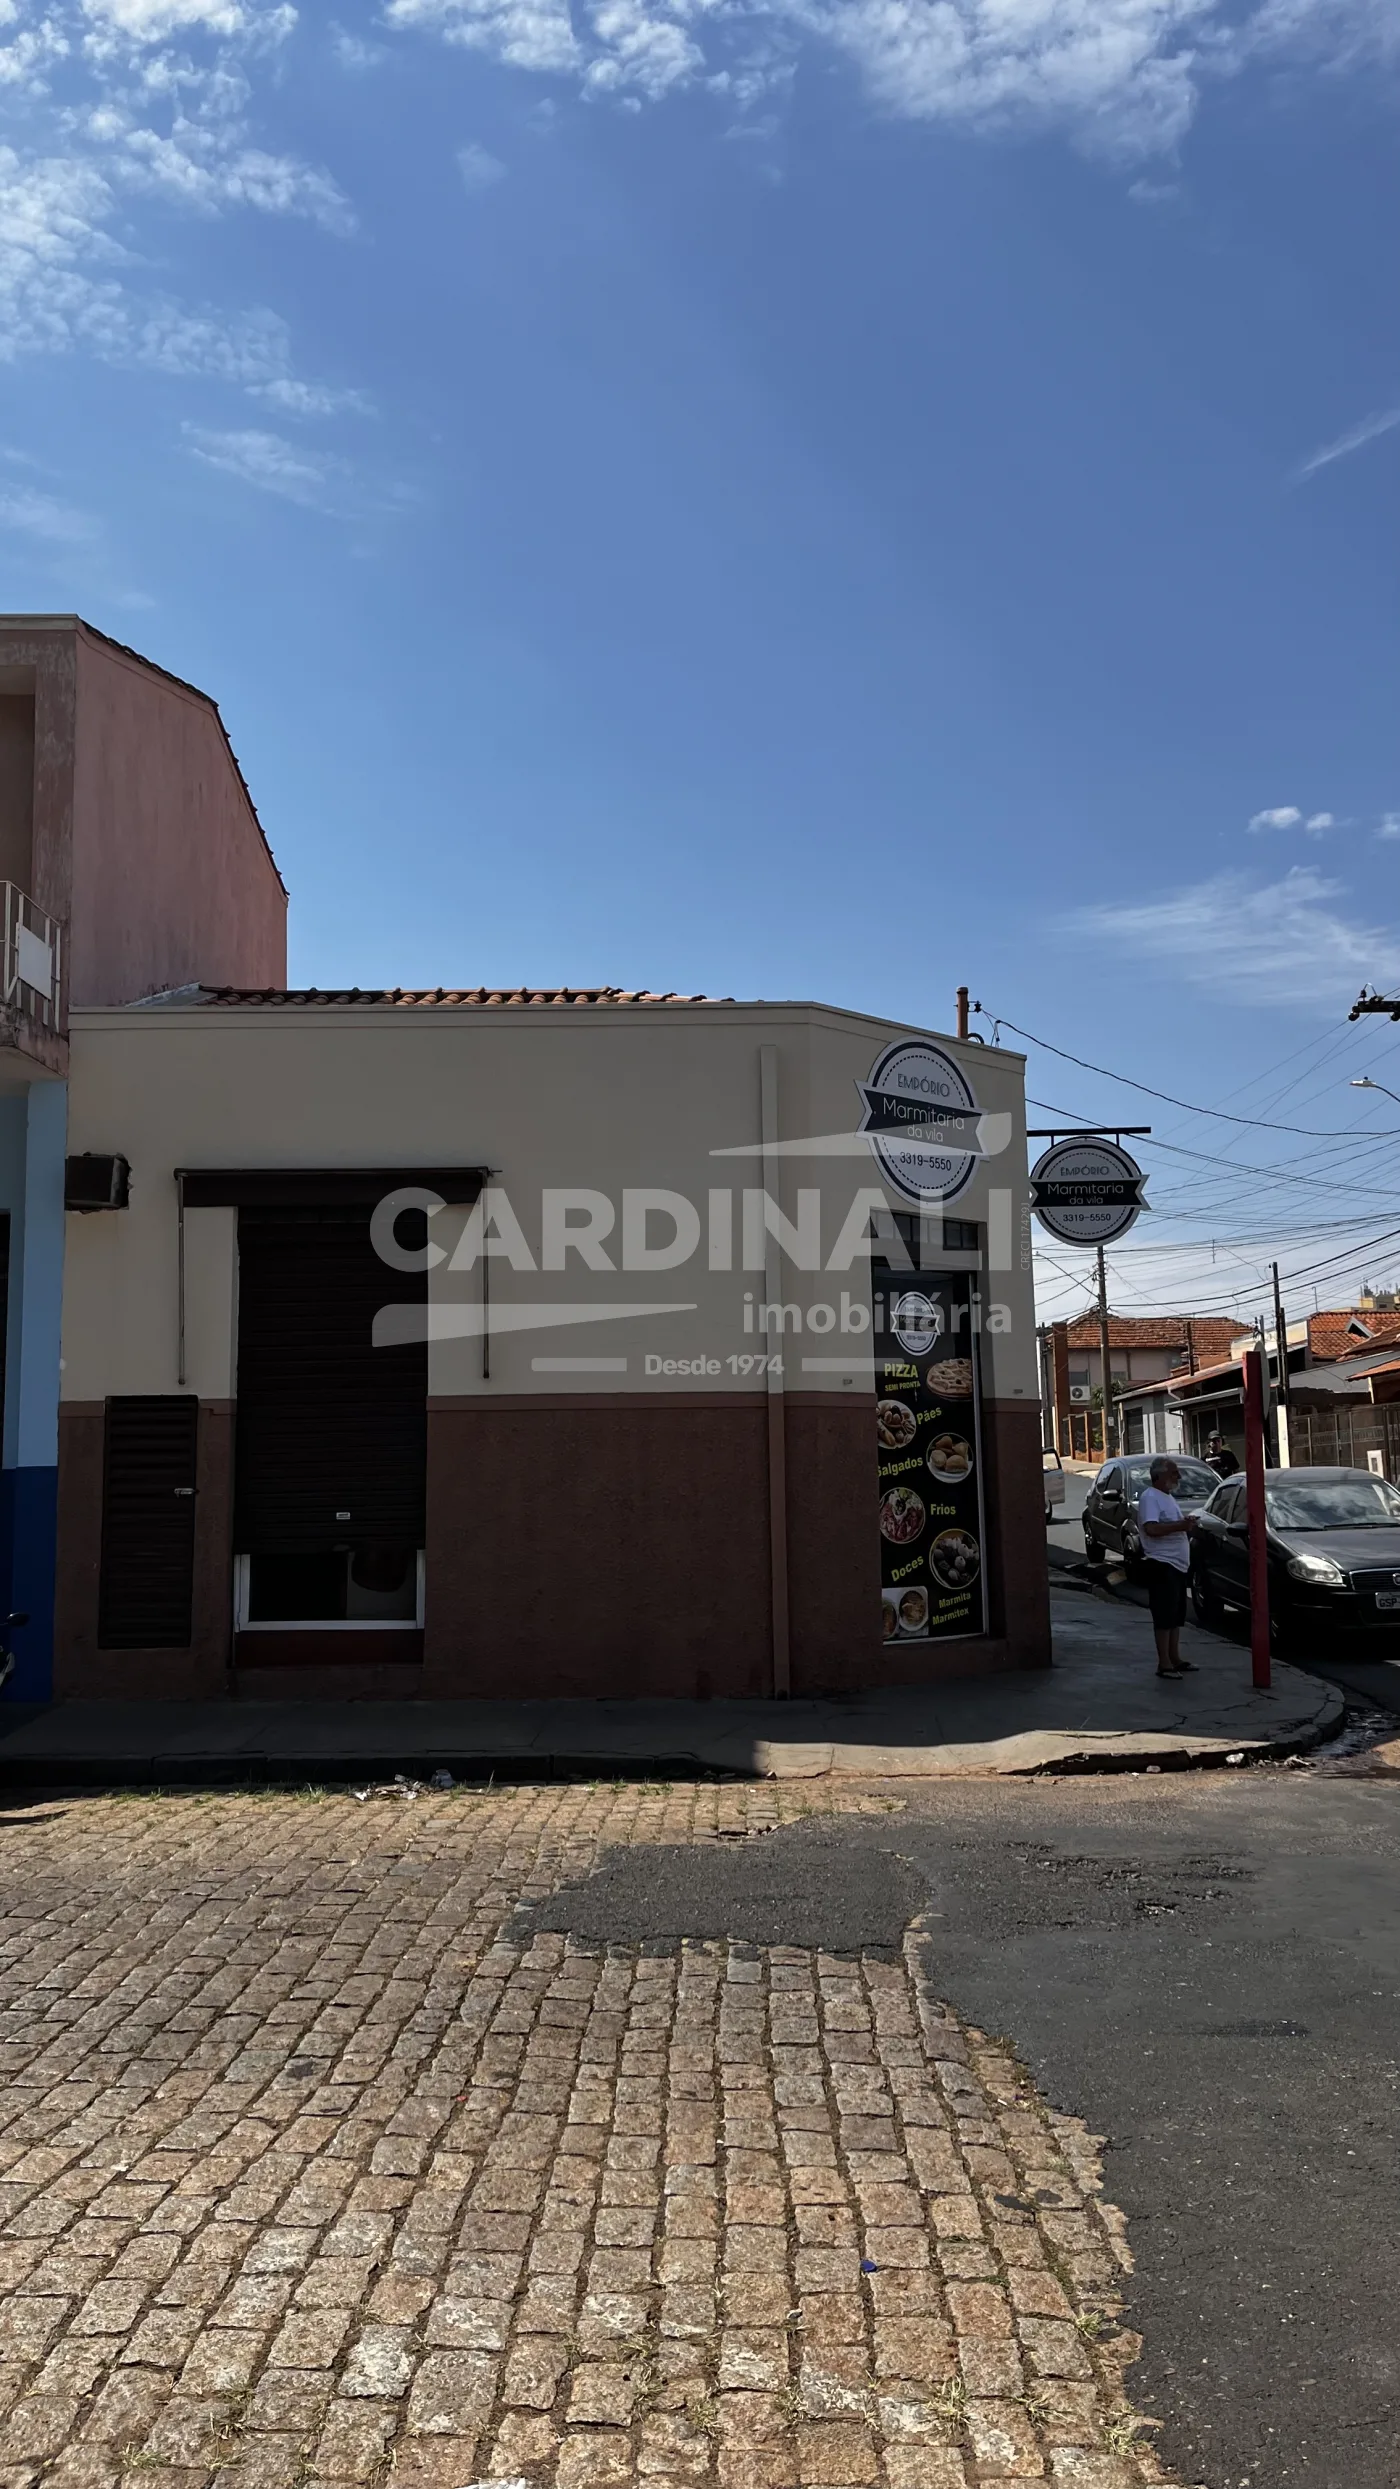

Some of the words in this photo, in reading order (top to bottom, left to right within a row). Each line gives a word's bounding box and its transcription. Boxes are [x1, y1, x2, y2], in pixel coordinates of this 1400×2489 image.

[897, 1073, 950, 1097] EMPÓRIO
[883, 1096, 965, 1130] Marmitaria
[907, 1124, 923, 1138] da
[925, 1128, 944, 1142] vila
[899, 1151, 952, 1171] 3319-5550
[1060, 1164, 1110, 1177] EMPÓRIO
[1047, 1182, 1124, 1195] Marmitaria
[1069, 1196, 1084, 1205] da
[1087, 1195, 1104, 1205] vila
[1062, 1213, 1111, 1222] 3319-5550
[884, 1362, 919, 1378] PIZZA
[884, 1383, 899, 1392] SEMI
[899, 1380, 921, 1390] PRONTA
[916, 1407, 942, 1425] Pães
[930, 1503, 956, 1516] Frios
[891, 1554, 924, 1582] Doces
[938, 1592, 972, 1609] Marmita
[932, 1606, 970, 1626] Marmitex
